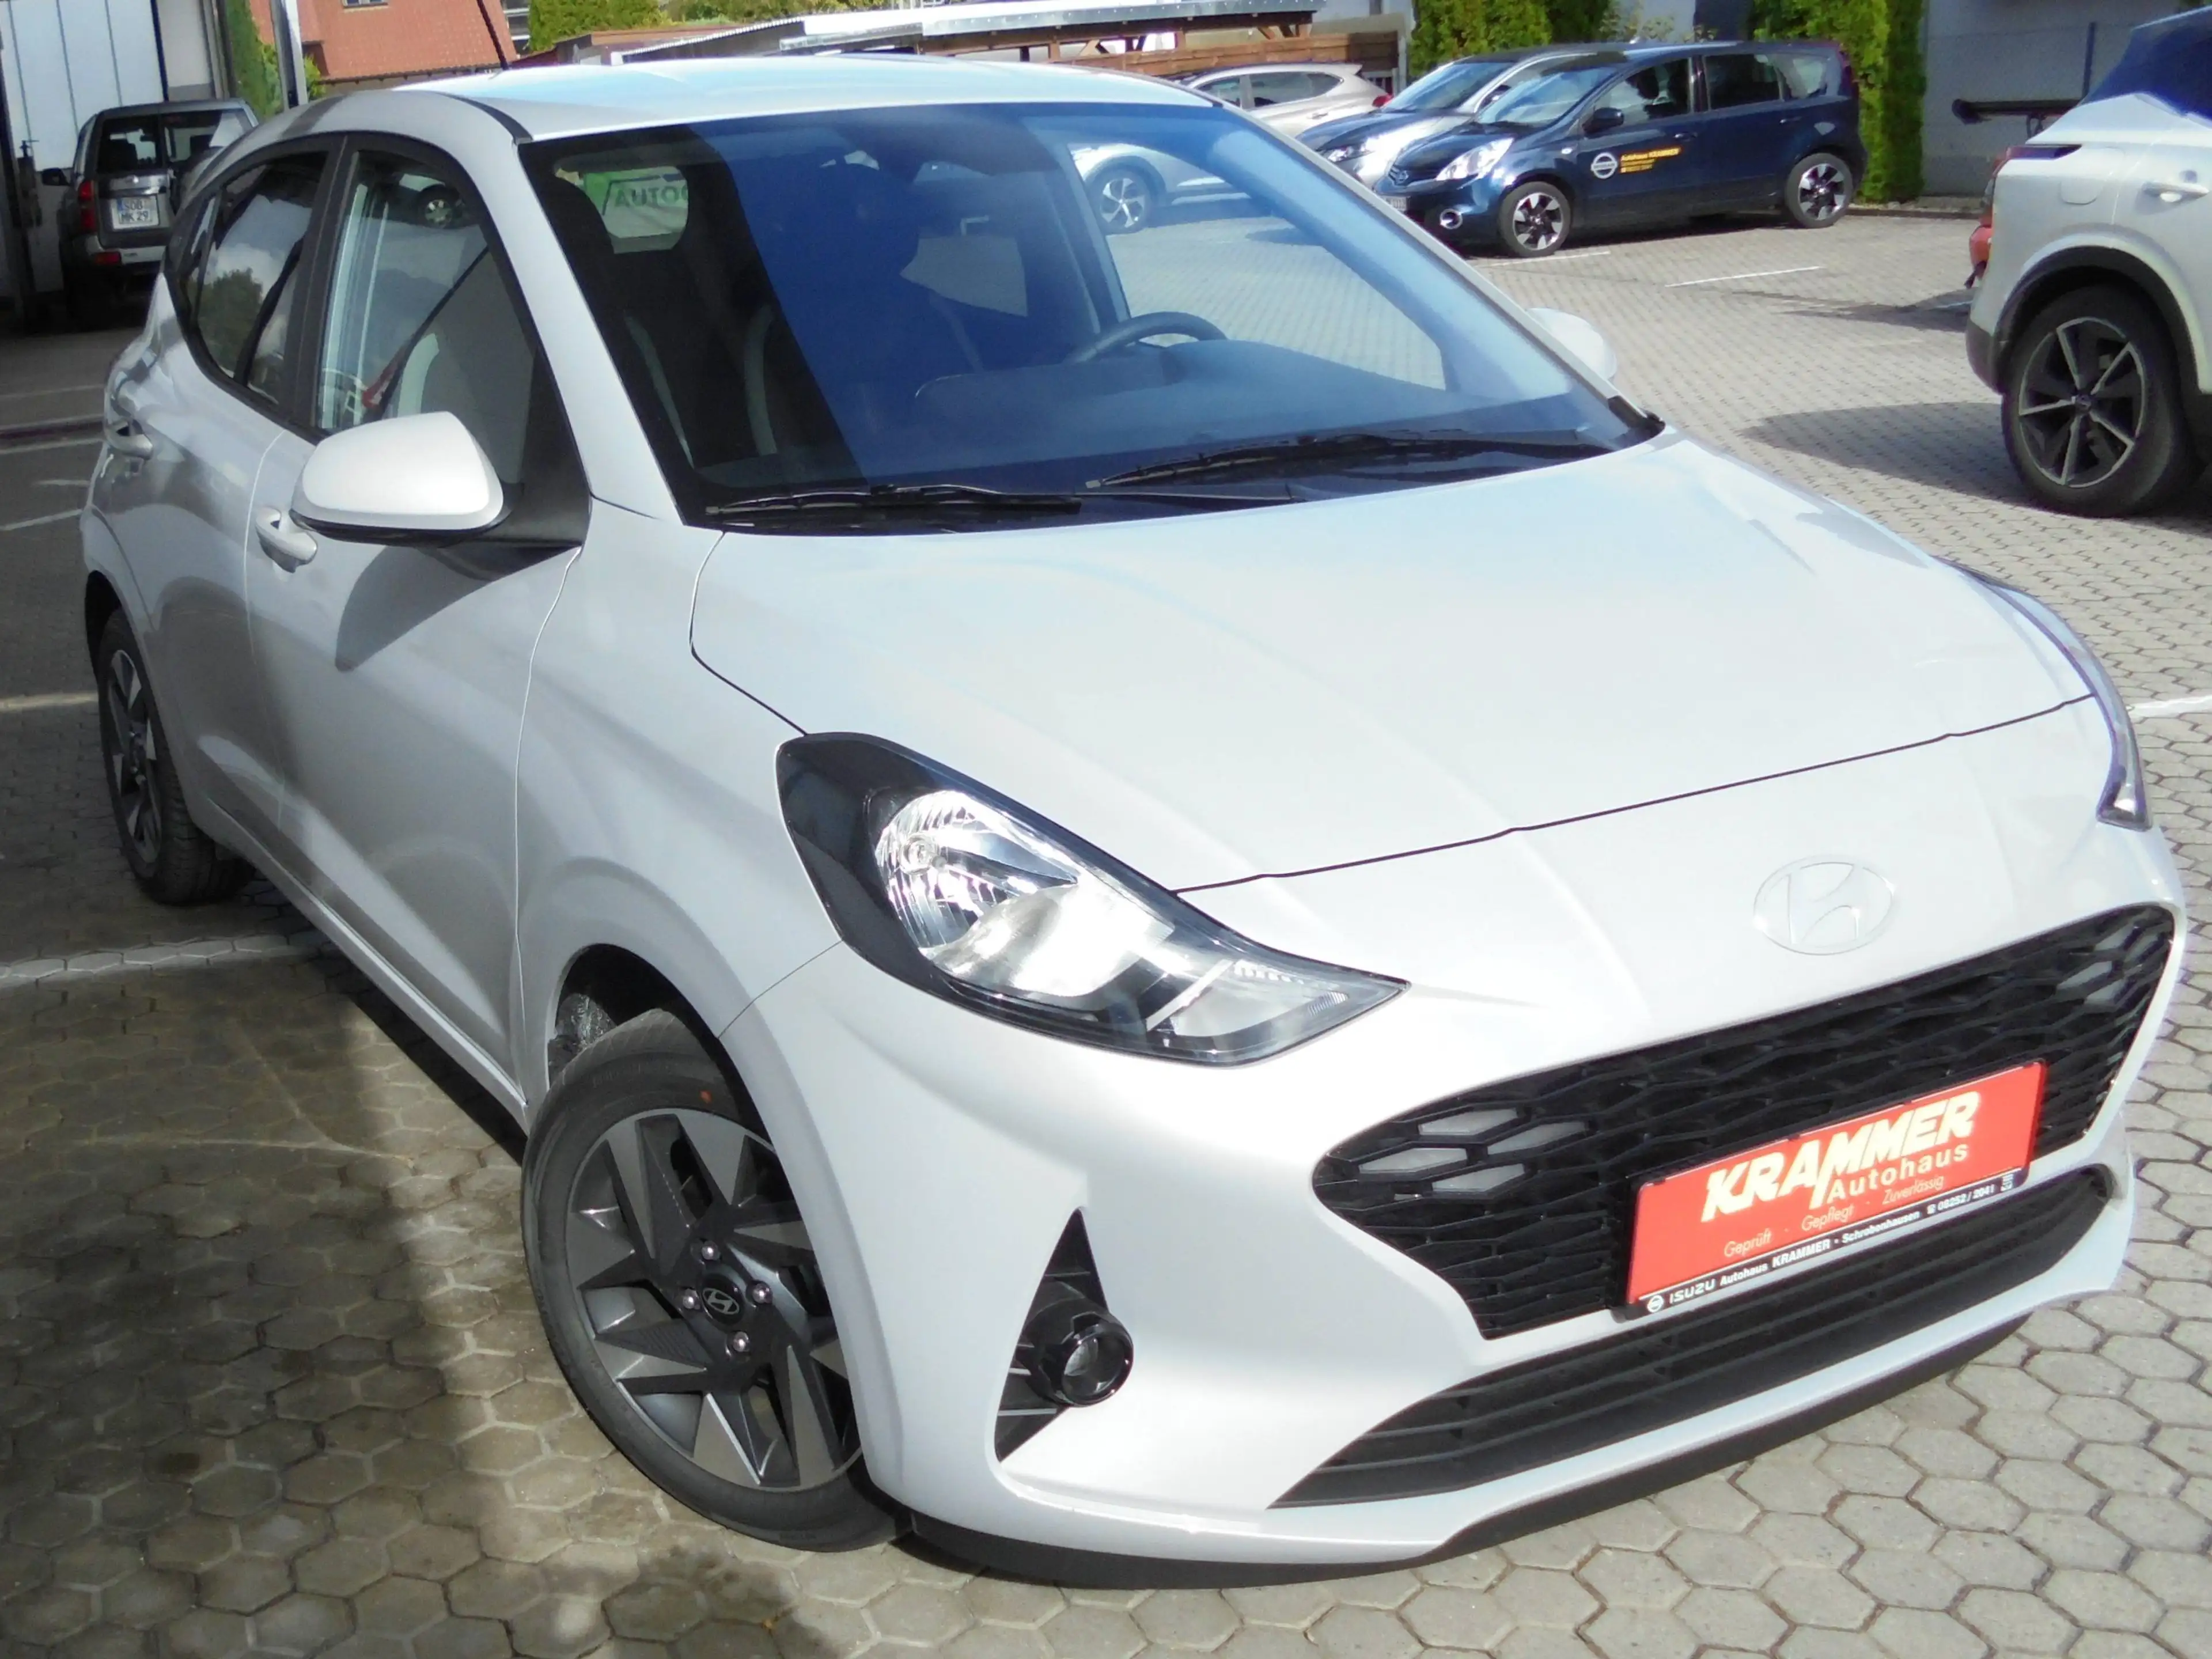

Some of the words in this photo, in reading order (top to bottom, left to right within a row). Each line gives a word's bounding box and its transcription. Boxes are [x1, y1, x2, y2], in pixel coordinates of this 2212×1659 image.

[1700, 1091, 1980, 1222] KRAMMER
[1826, 1143, 1969, 1204] Autohaus
[1724, 1228, 1772, 1258] Geprüft
[1801, 1205, 1854, 1232] Gepflegt
[1881, 1175, 1945, 1205] Zuverlässig
[1669, 1278, 1716, 1304] ISUZU
[1719, 1263, 1768, 1286] Autohaus
[1772, 1238, 1831, 1268] KRAMMER
